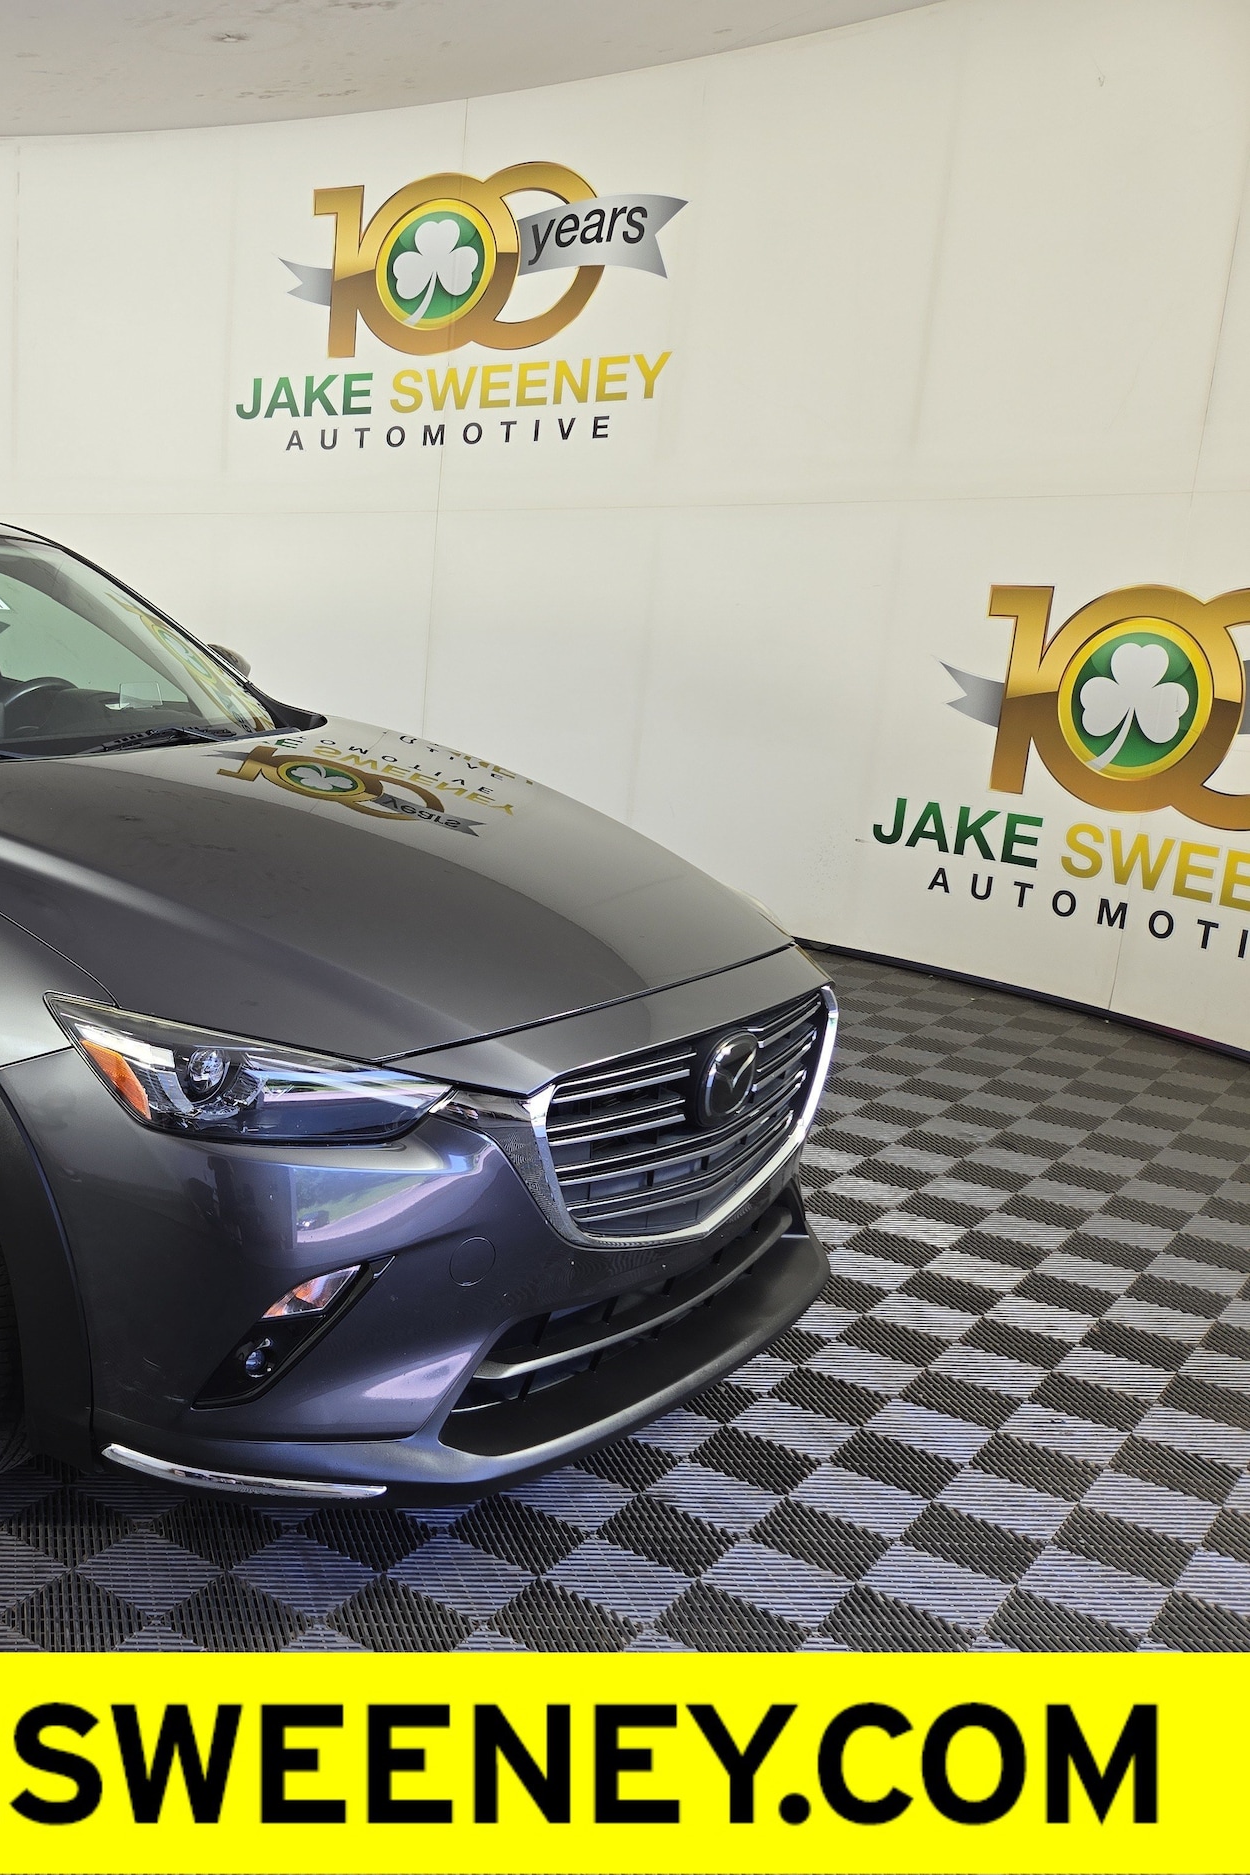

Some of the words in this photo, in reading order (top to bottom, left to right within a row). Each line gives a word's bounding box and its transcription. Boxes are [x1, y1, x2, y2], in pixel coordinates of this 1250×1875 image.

[313, 161, 605, 358] 100
[528, 206, 648, 265] years
[236, 373, 373, 420] JAKE
[389, 351, 673, 414] SWEENEY
[285, 416, 610, 451] AUTOMOTIVE
[873, 797, 1043, 868] JAKE
[1061, 822, 1250, 912] SWEE
[927, 867, 1250, 959] AUTOMOTI
